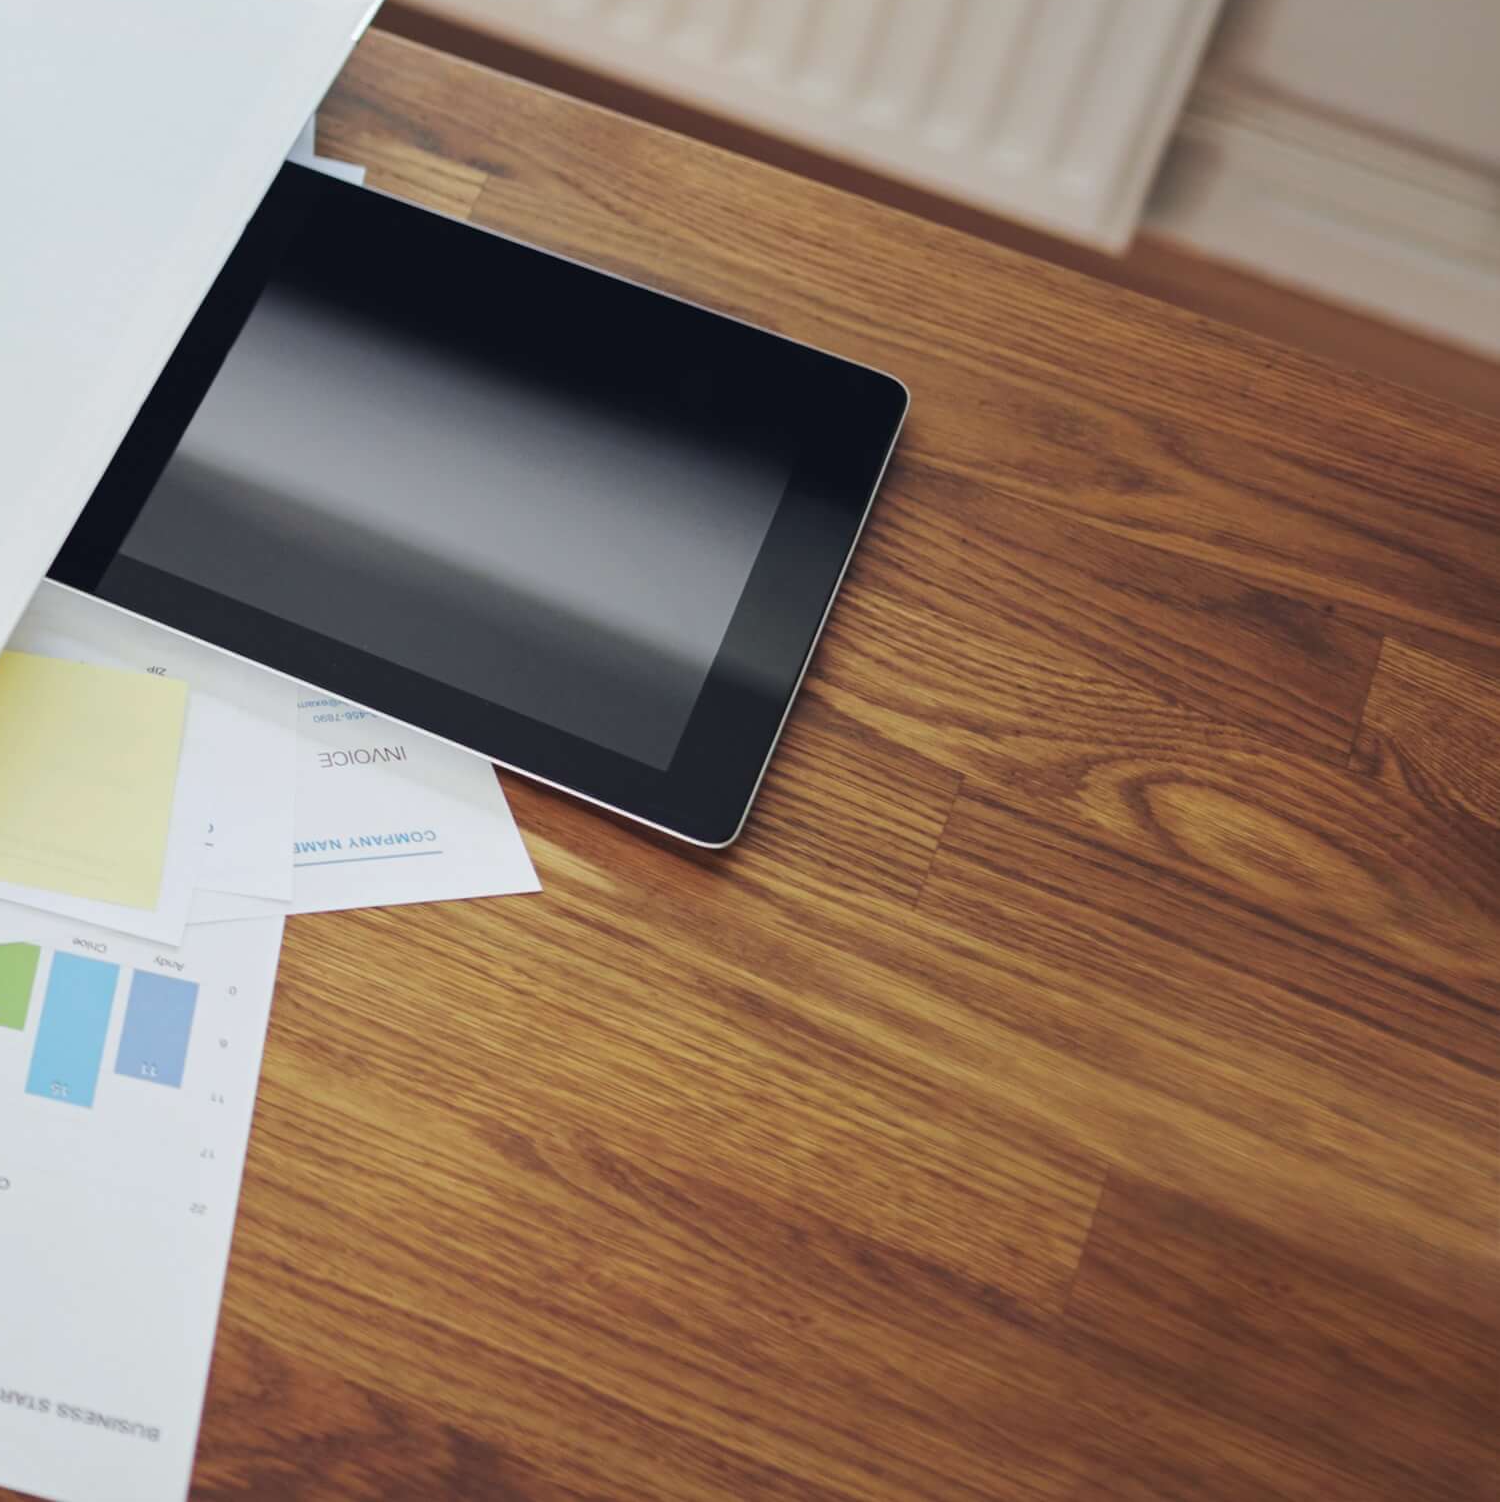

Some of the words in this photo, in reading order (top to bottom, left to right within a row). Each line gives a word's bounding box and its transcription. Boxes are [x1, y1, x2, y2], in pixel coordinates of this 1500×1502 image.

[147, 666, 167, 676] ZIP
[319, 746, 407, 768] INVOICE
[294, 840, 342, 854] NAME
[350, 830, 437, 848] COMPANY
[72, 938, 108, 954] Chloe
[154, 956, 185, 972] Andy
[56, 1404, 160, 1442] BUSINESS
